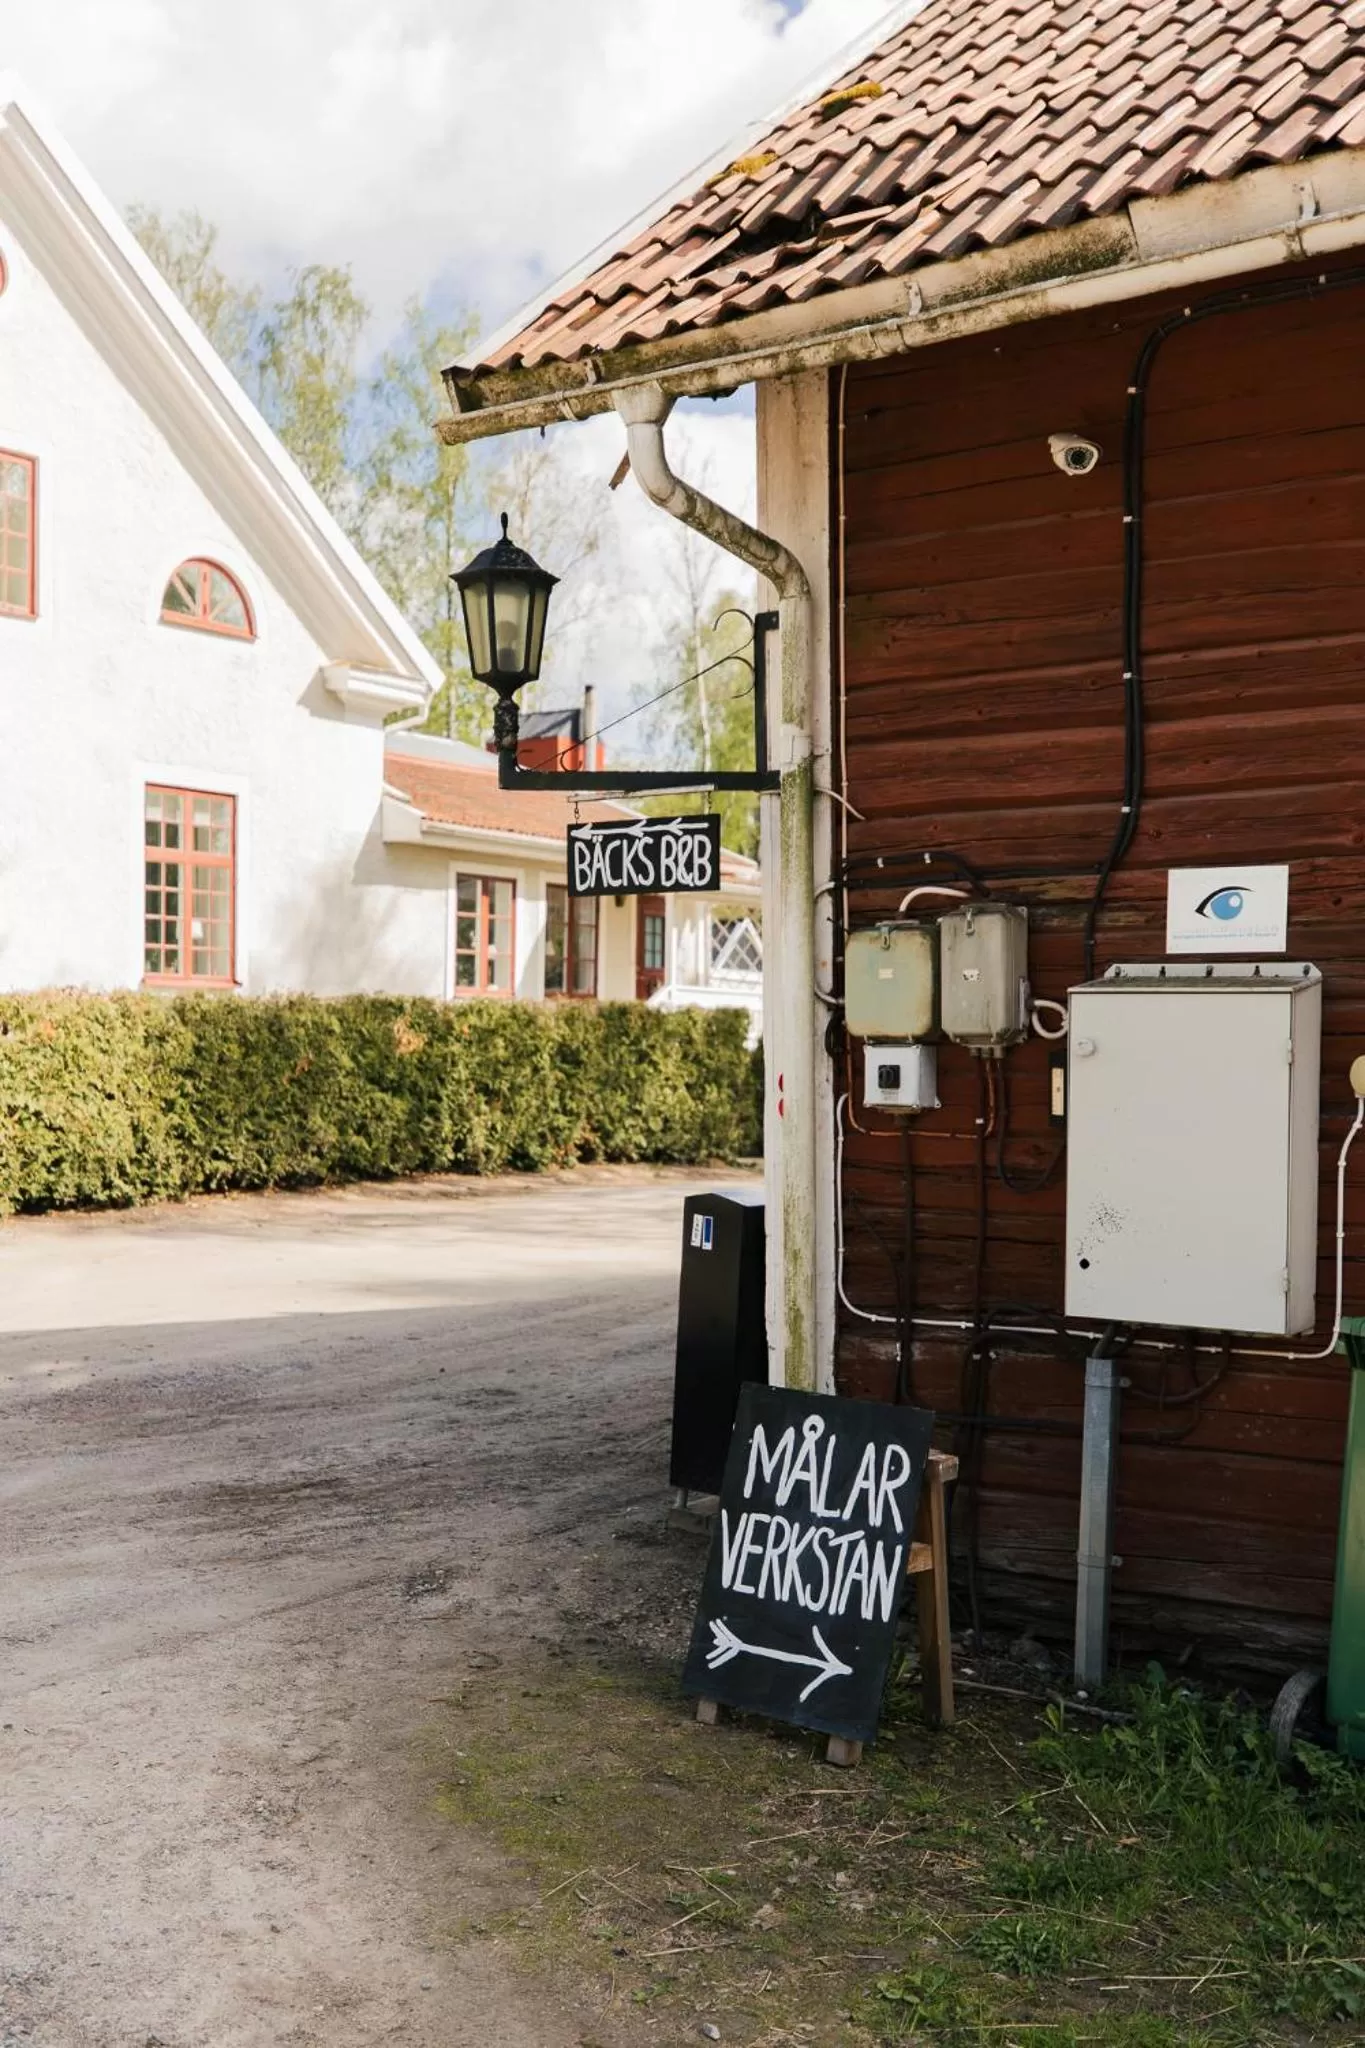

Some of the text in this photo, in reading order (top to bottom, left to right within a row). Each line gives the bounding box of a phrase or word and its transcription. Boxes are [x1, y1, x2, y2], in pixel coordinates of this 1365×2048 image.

[574, 834, 712, 892] BÄCKS B&B
[743, 1414, 911, 1533] MÅLAR
[721, 1508, 903, 1622] VERKSTAN
